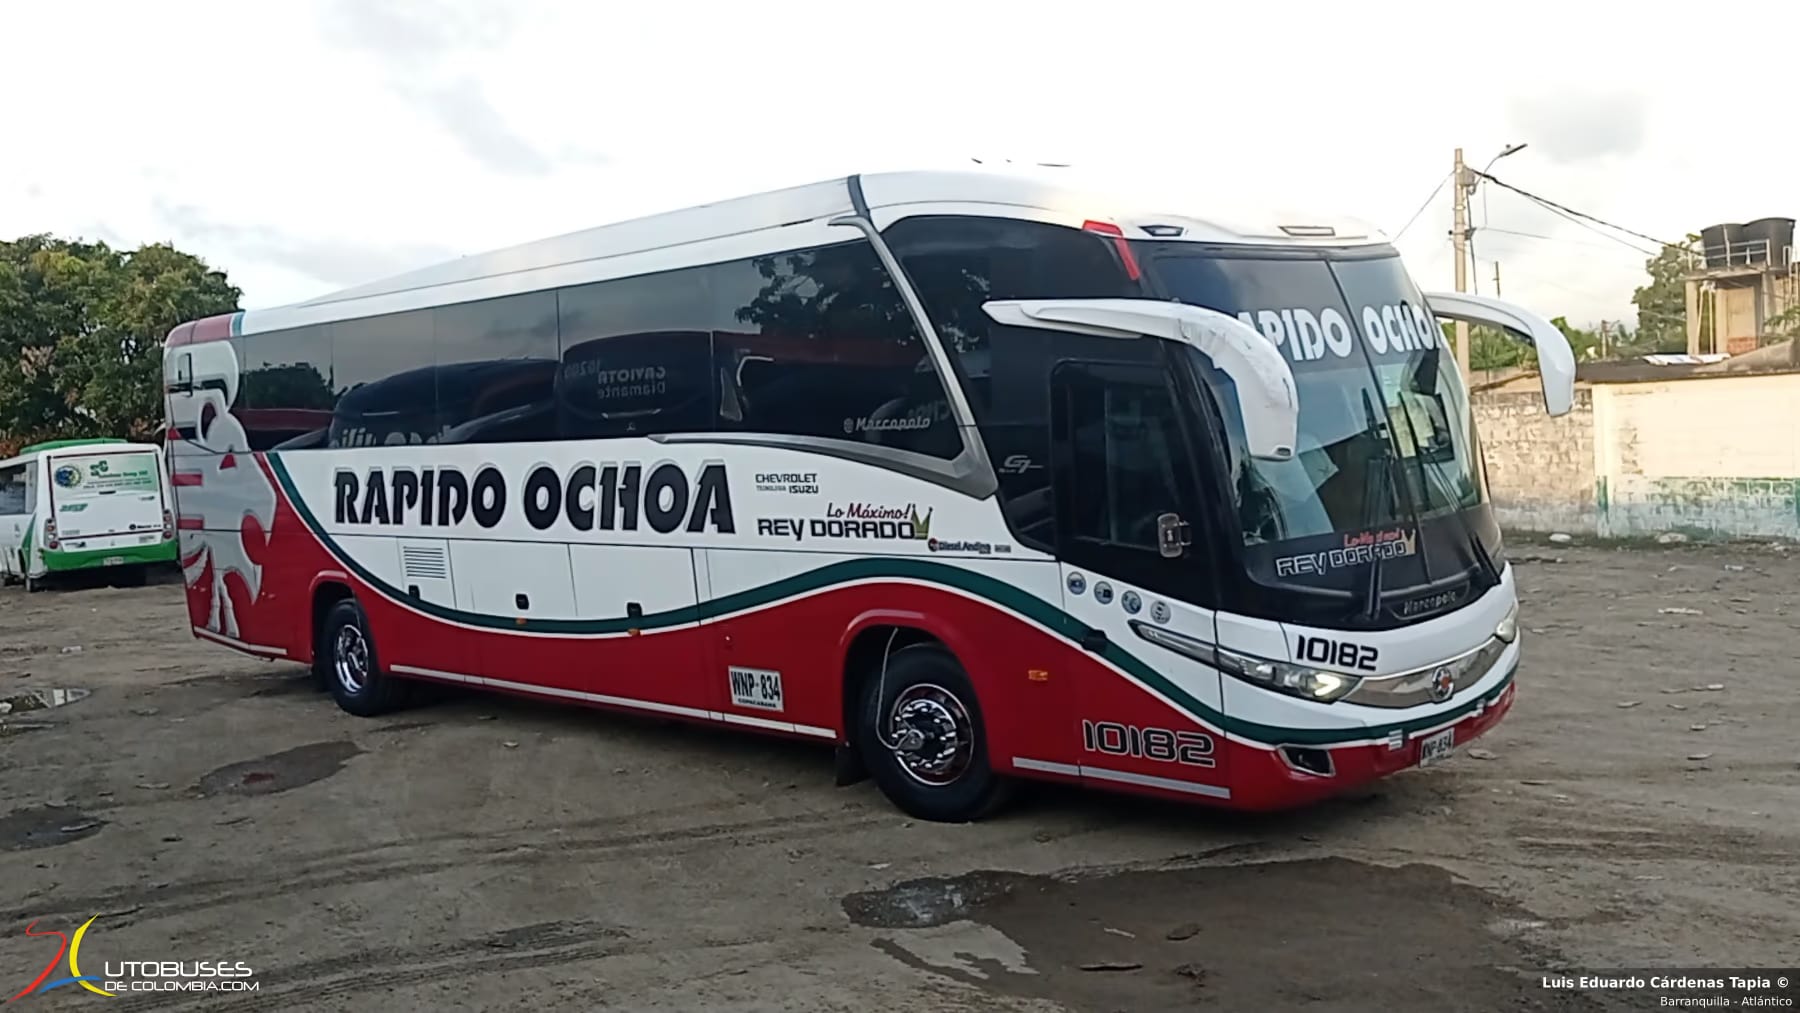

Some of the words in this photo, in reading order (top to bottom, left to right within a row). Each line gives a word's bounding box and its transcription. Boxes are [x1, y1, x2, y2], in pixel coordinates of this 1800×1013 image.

[755, 473, 818, 484] CHEVROLET
[789, 485, 819, 494] ISUZU
[335, 464, 507, 529] RAPIDO
[523, 459, 736, 534] OCHOA
[827, 502, 845, 518] Lo
[847, 502, 912, 520] Máximo!
[757, 518, 805, 542] REY
[810, 520, 915, 540] DORADO
[1275, 551, 1328, 577] REY
[1329, 539, 1408, 568] DORADO
[1296, 634, 1379, 672] 10182
[731, 671, 781, 701] WNP-834
[1082, 719, 1216, 768] 10182
